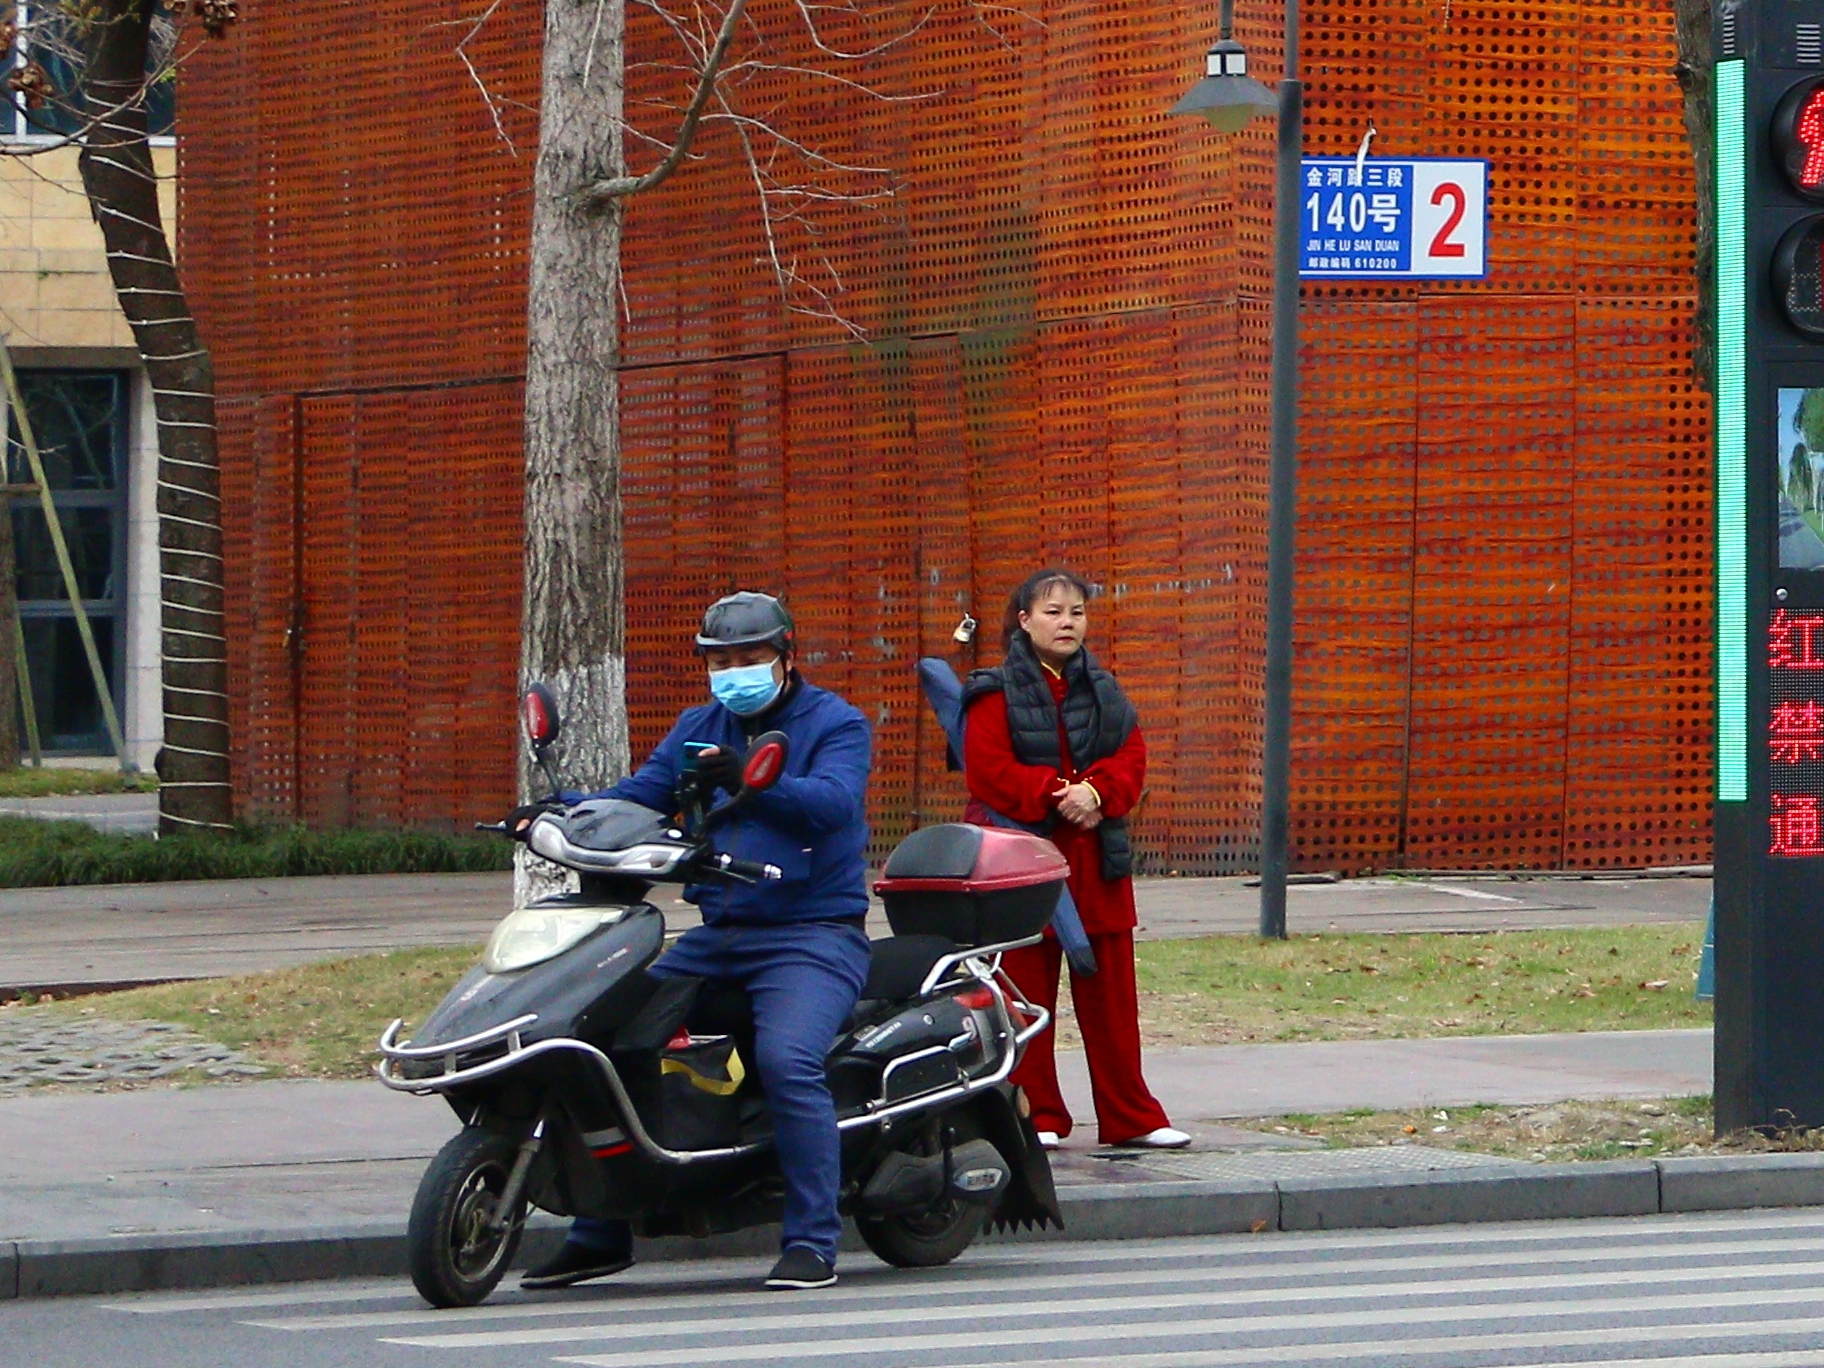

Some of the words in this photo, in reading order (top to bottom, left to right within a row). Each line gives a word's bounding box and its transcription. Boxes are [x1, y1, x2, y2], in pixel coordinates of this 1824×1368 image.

[1307, 167, 1403, 187] 金河路三段
[1307, 192, 1400, 232] 140号
[1428, 181, 1466, 258] 2
[1307, 239, 1321, 251] JIN
[1324, 239, 1336, 251] HE
[1339, 239, 1351, 252] LU
[1354, 239, 1372, 252] SAN
[1375, 239, 1399, 252] DUAN
[1354, 257, 1397, 269] 610200
